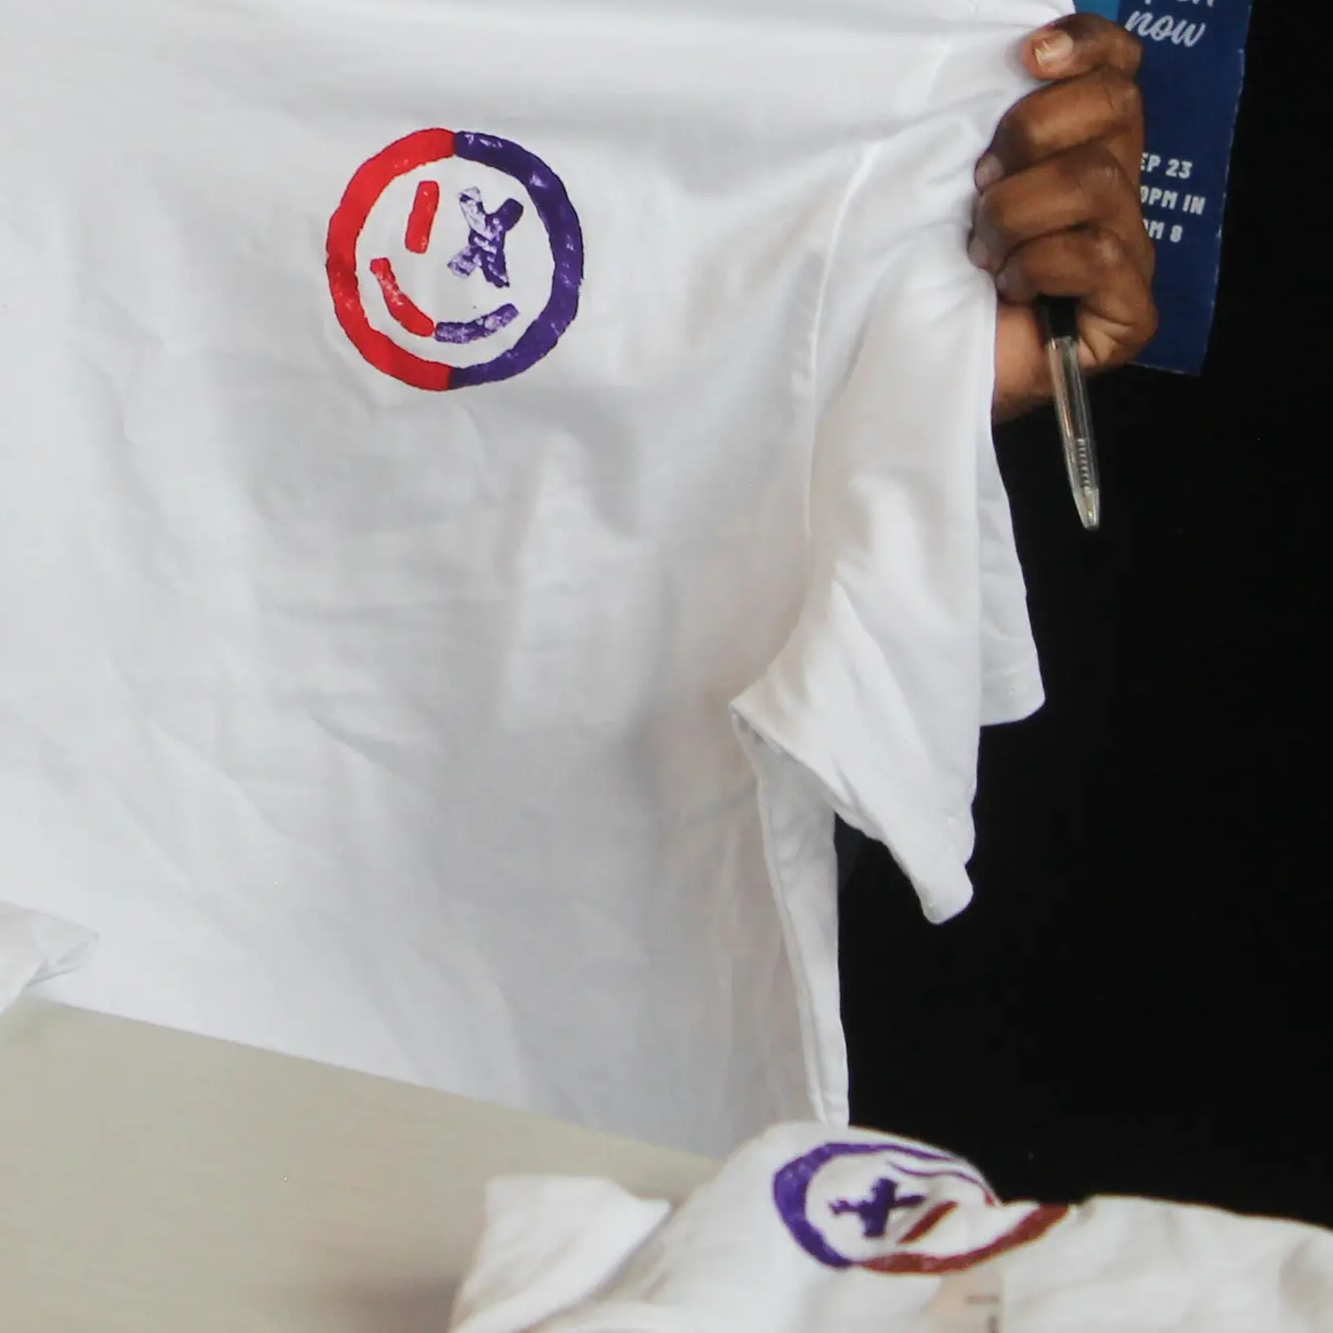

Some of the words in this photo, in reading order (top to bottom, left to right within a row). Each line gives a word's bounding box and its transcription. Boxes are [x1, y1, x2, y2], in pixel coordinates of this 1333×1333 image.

[1124, 8, 1207, 48] now
[1165, 158, 1193, 180] 23
[1183, 194, 1207, 216] IN
